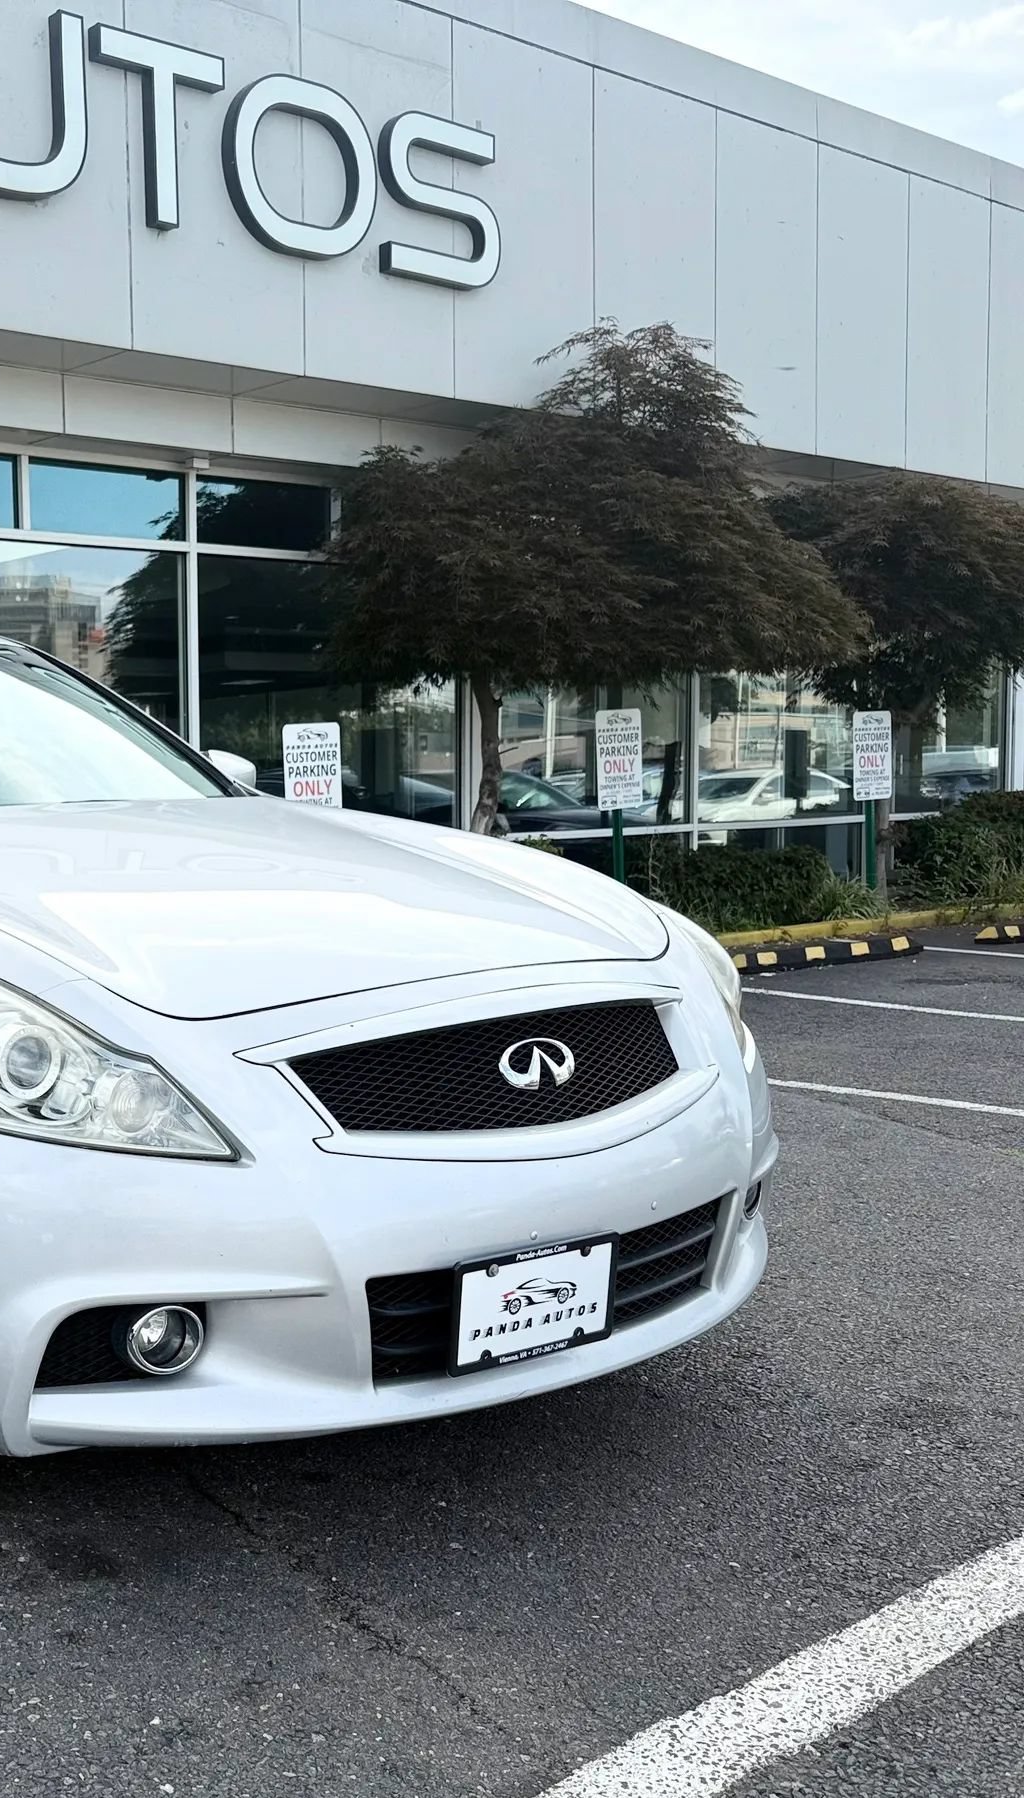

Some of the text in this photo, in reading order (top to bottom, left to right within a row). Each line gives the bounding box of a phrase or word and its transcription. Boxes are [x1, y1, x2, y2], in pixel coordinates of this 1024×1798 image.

[597, 733, 640, 745] CUSTOMER
[854, 732, 890, 743] CUSTOMER
[599, 745, 639, 758] PARKING
[855, 743, 889, 754] PARKING
[285, 750, 338, 764] CUSTOMER
[858, 755, 886, 769] ONLY
[288, 764, 337, 779] PARKING
[603, 758, 635, 774] ONLY
[604, 775, 627, 783] TOWING
[293, 779, 332, 797] ONLY
[469, 1302, 598, 1341] PANDA AUTOS
